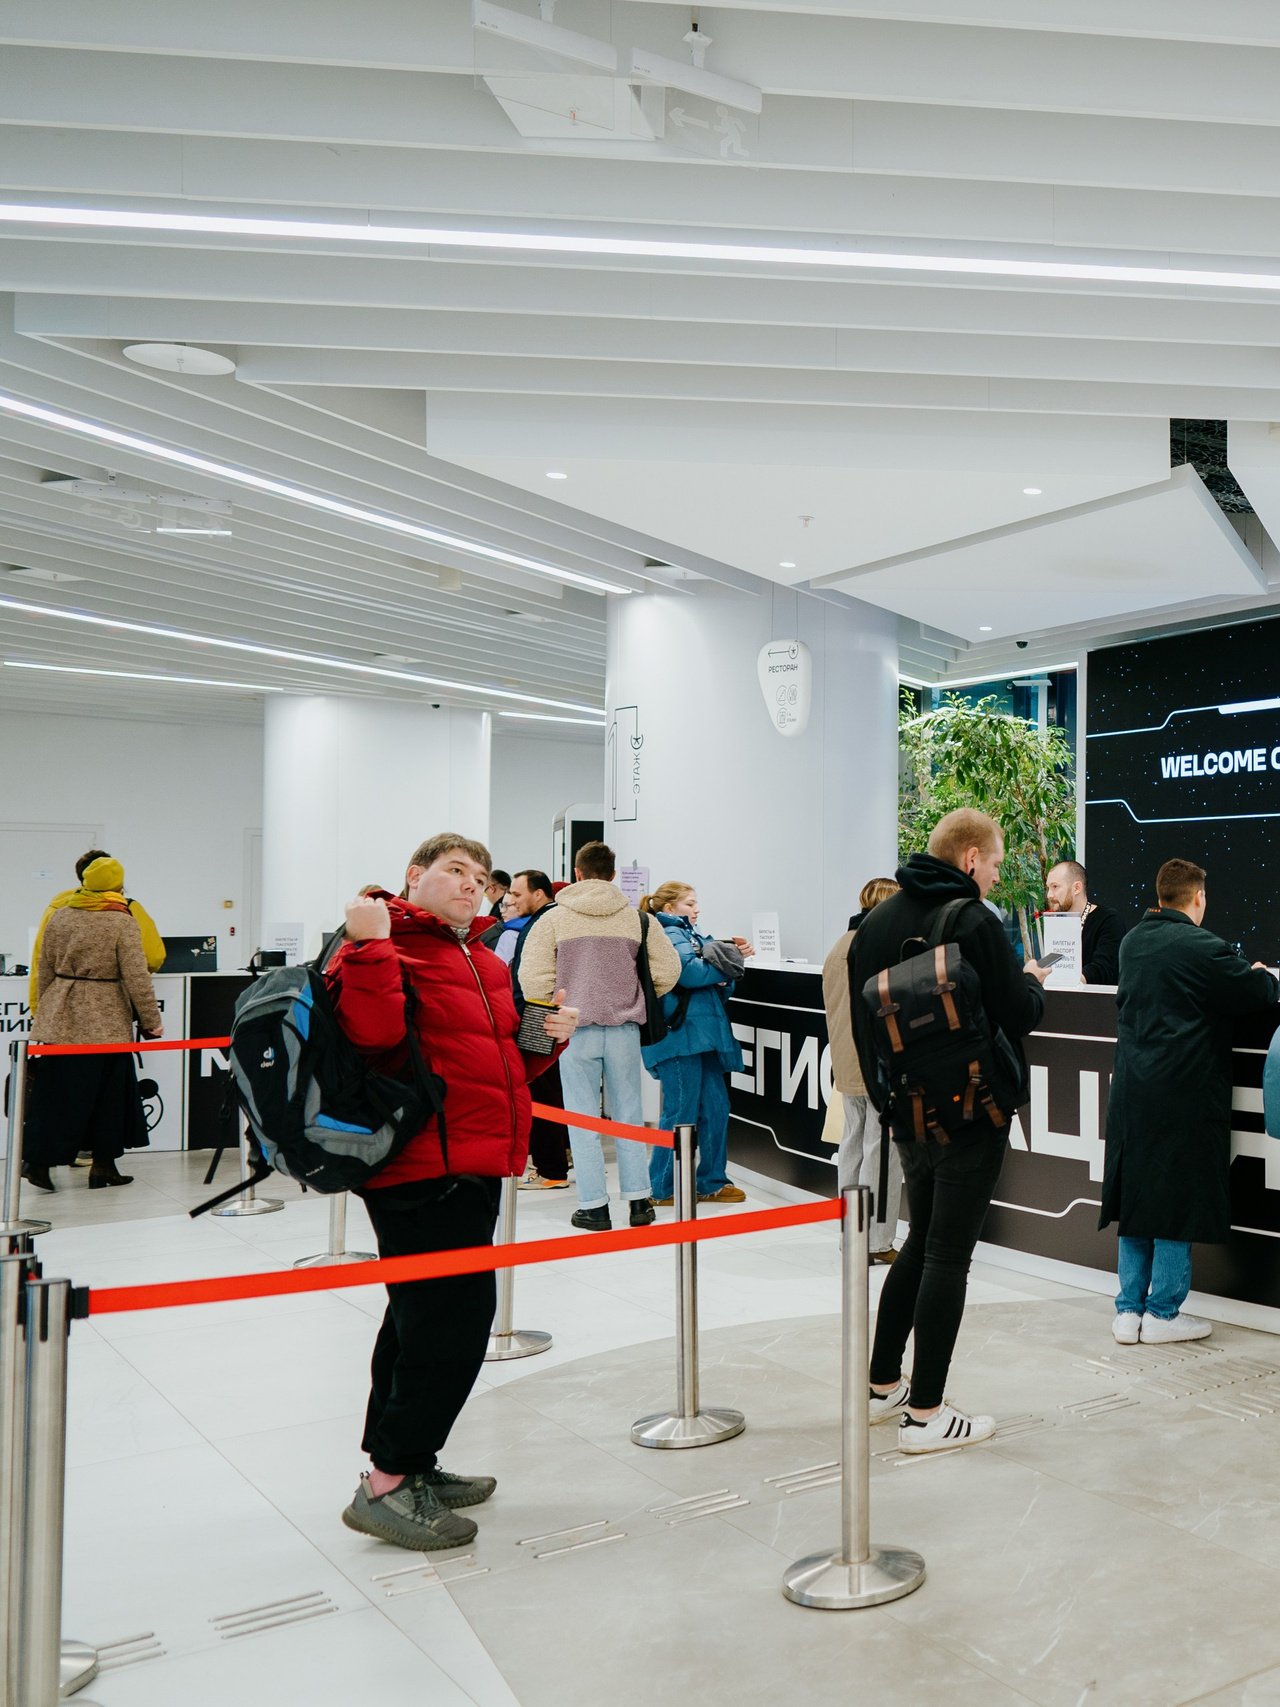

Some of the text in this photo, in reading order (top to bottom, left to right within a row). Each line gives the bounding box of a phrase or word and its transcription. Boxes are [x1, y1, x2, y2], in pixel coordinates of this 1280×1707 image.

[768, 664, 798, 673] РЕСТОРАН
[633, 752, 641, 794] ЭТАЖ
[1161, 748, 1267, 779] WELCOME
